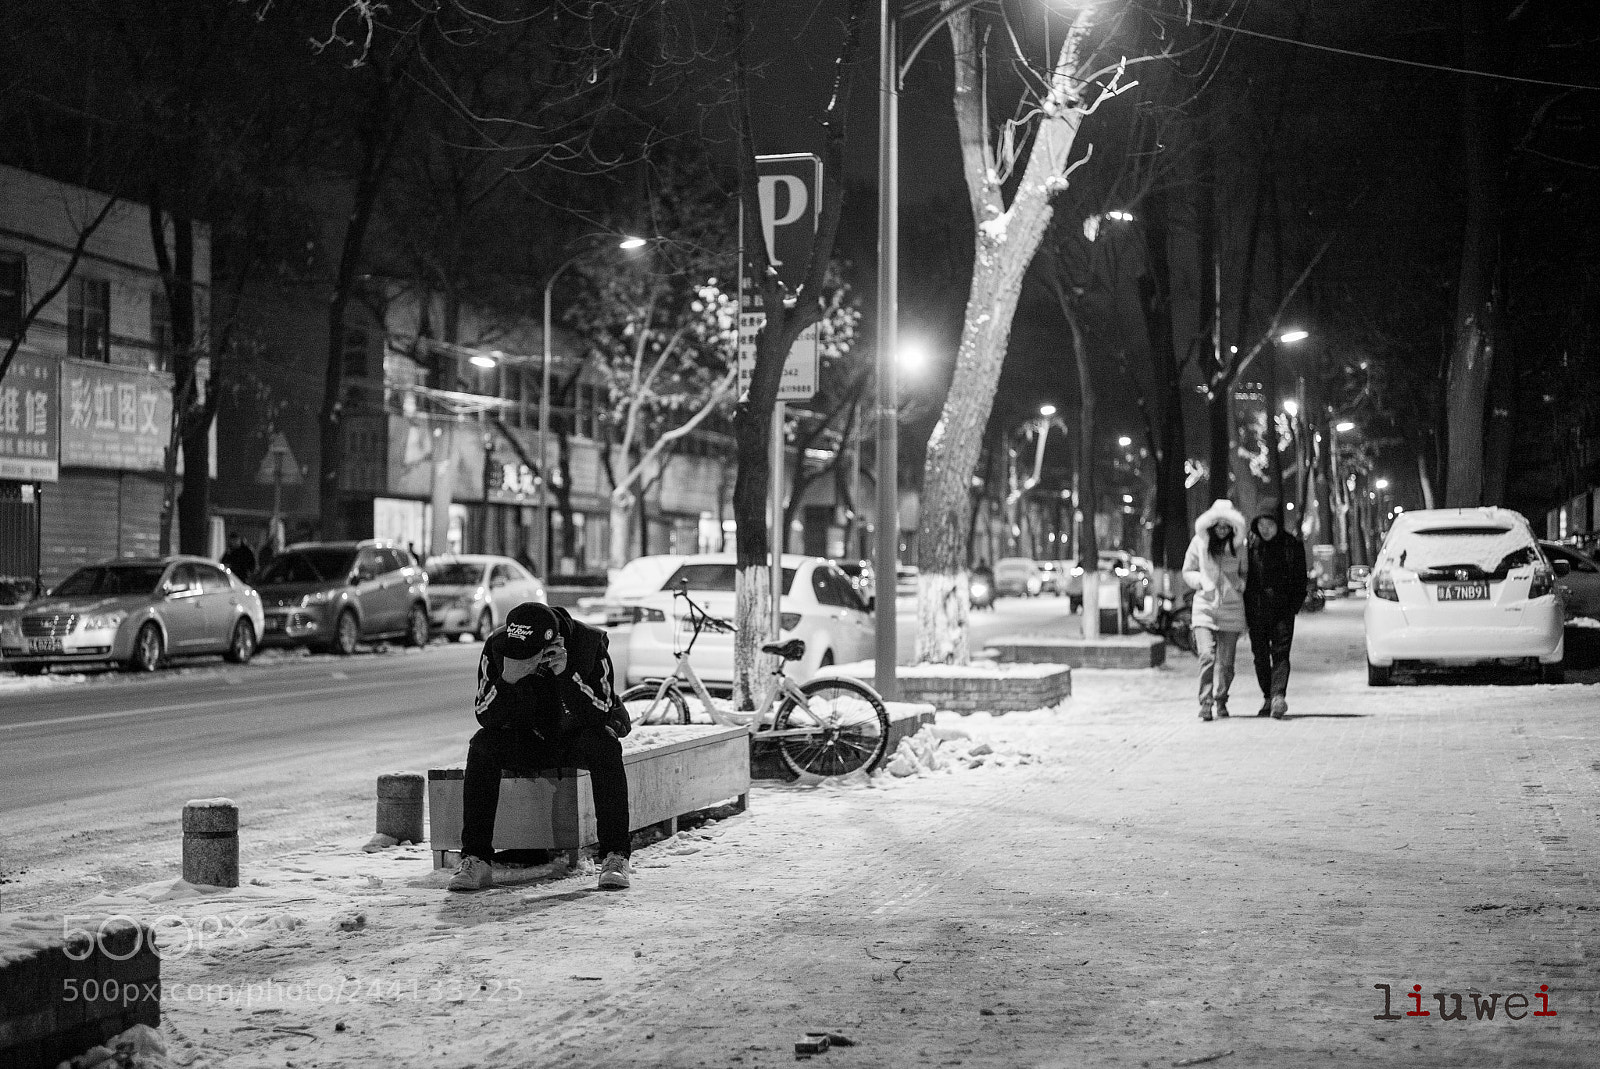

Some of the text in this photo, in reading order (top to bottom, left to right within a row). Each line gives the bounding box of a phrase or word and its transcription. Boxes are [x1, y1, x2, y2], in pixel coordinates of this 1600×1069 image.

[757, 175, 808, 266] P
[70, 377, 159, 436] 彩虹图文
